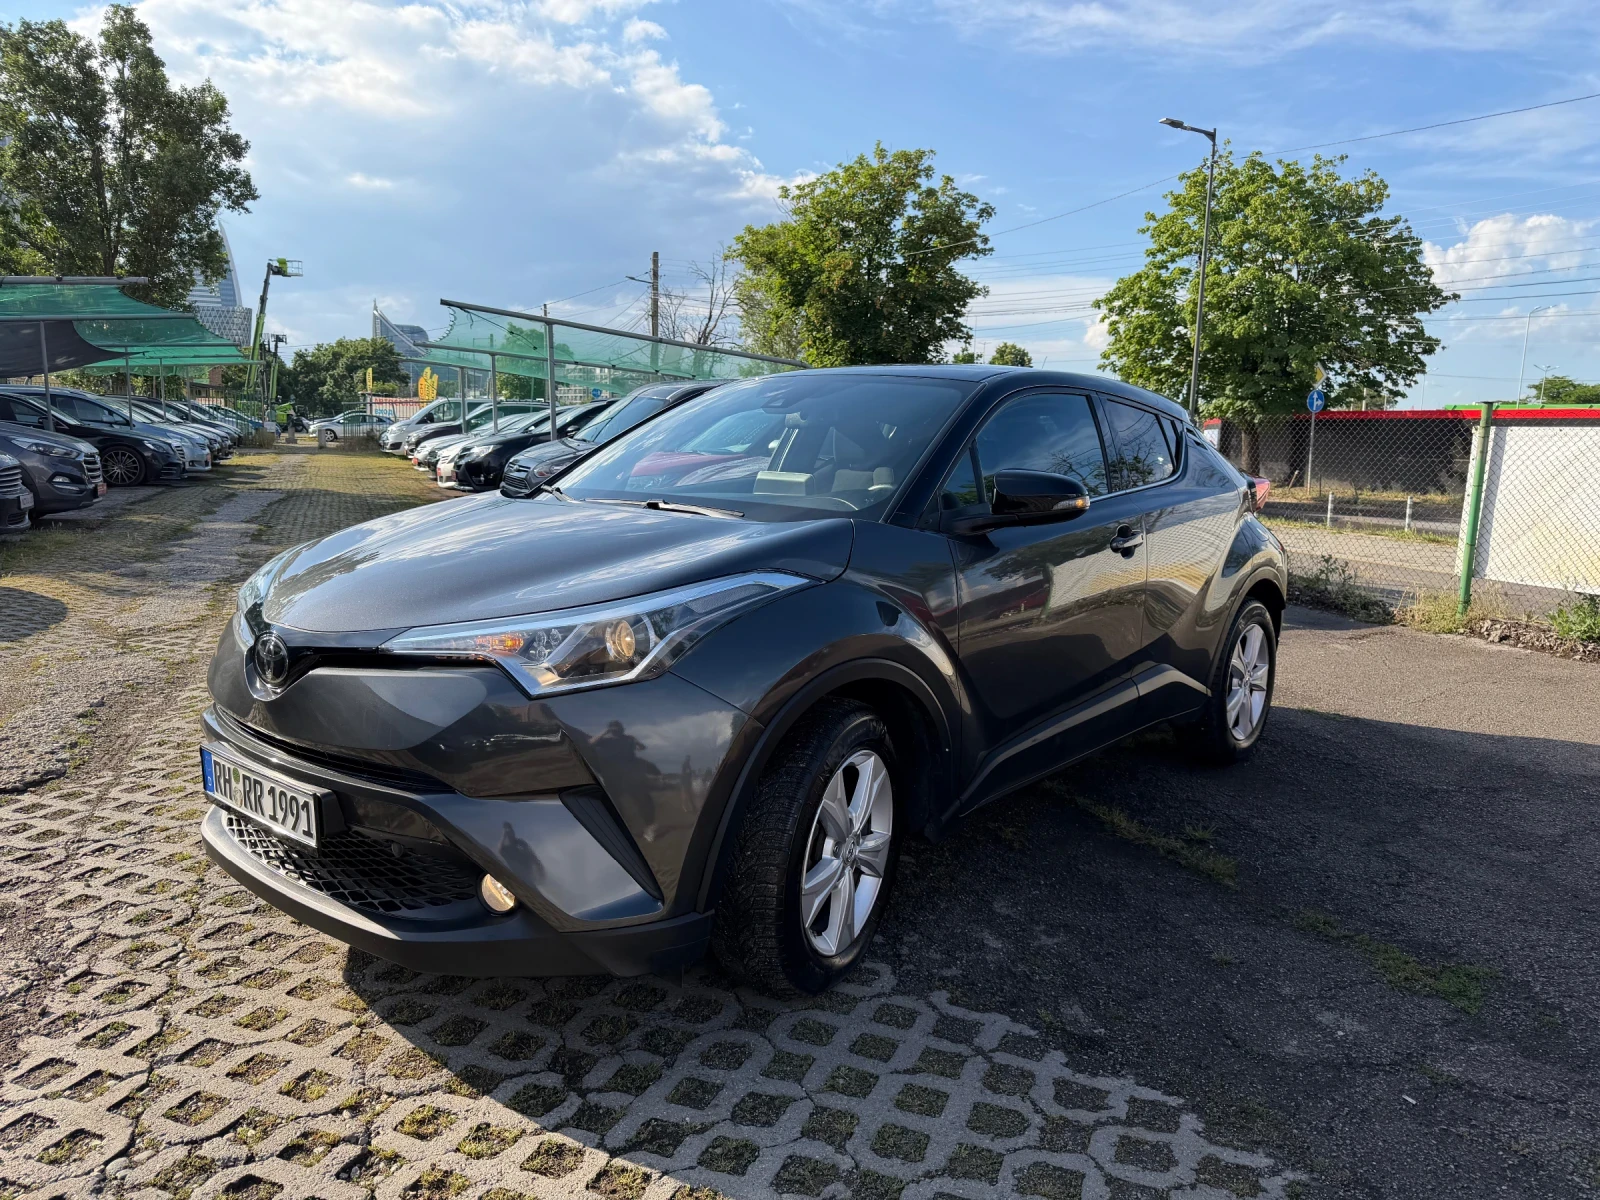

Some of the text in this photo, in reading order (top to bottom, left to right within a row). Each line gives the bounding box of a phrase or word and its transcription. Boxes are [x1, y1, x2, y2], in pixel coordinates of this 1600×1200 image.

[213, 760, 233, 801] RH
[242, 774, 265, 817] RR
[268, 786, 313, 838] 1991
